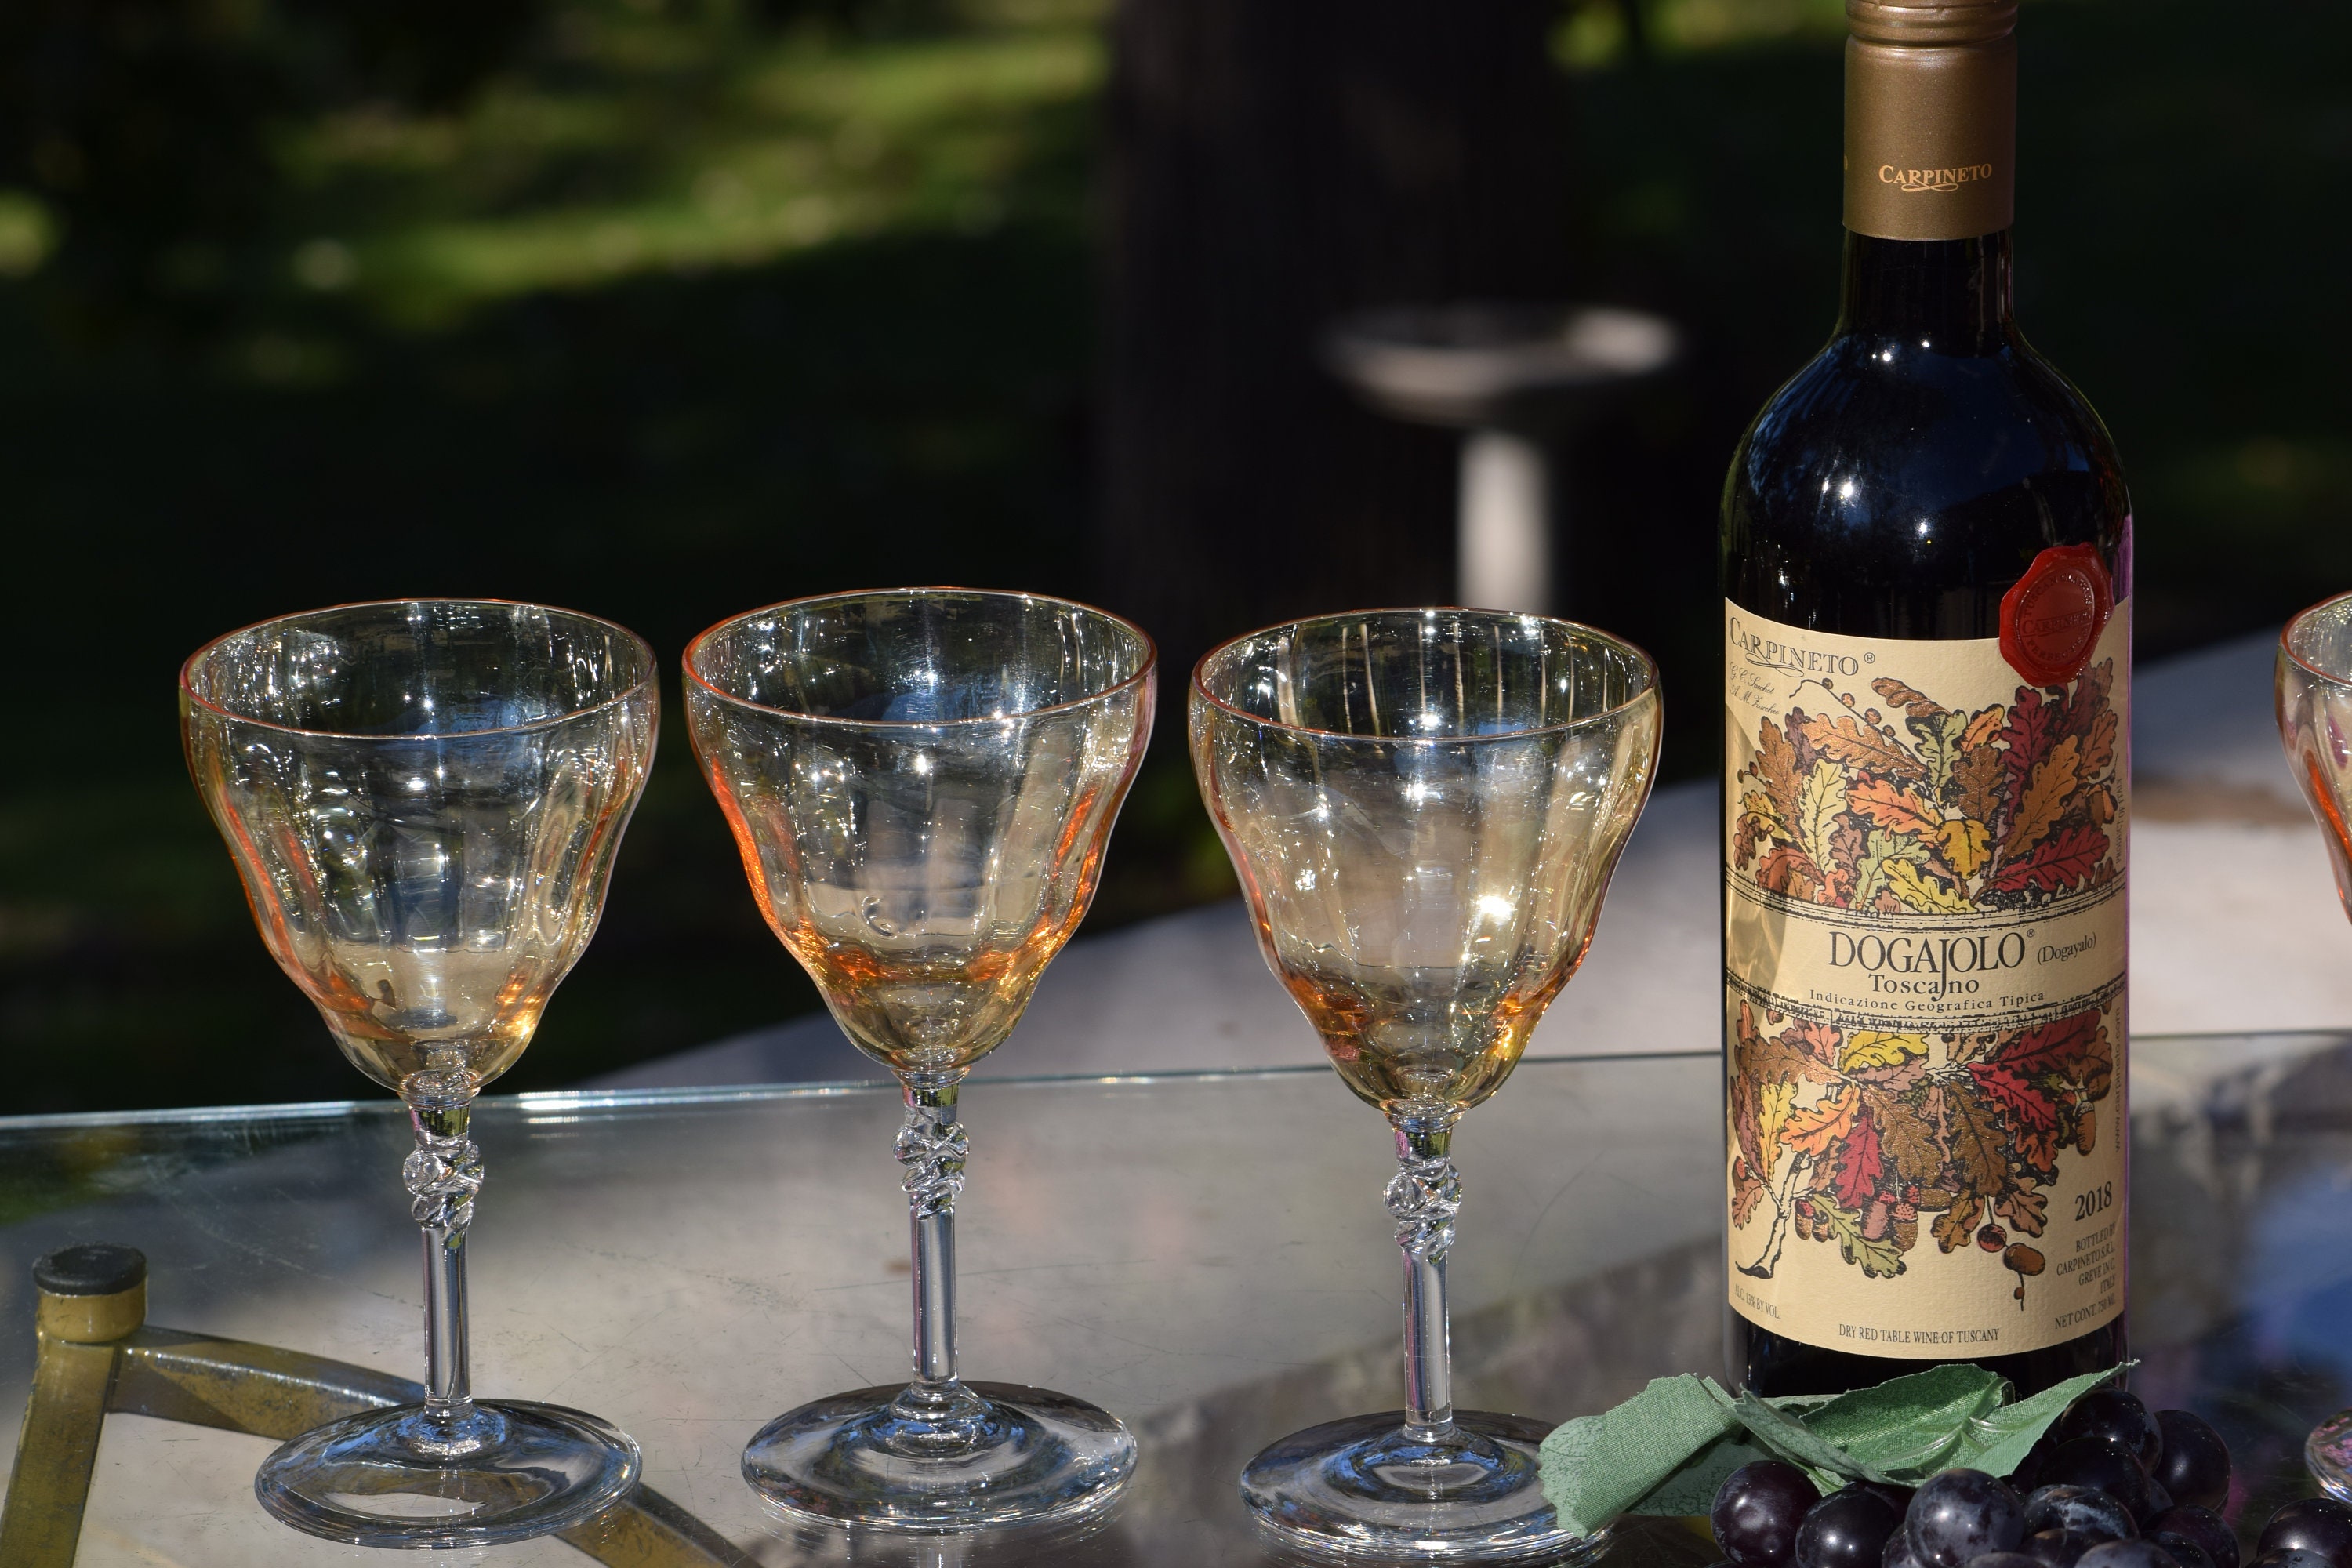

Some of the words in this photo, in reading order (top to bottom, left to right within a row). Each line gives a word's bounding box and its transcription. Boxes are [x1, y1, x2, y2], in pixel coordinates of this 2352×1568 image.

[1878, 163, 1992, 191] CARPINETO
[2037, 931, 2096, 965] (Dogayalo)
[1828, 931, 2025, 1001] DOGAJOLO
[1809, 989, 1898, 1011] Indicazione
[1905, 999, 1992, 1013] Geografica
[1999, 993, 2045, 1008] Tipica
[2074, 1181, 2112, 1221] 2018
[2076, 1227, 2109, 1253] BOTTLED
[2056, 1250, 2100, 1276] CARPINETO
[2078, 1265, 2101, 1286] GREVE
[2100, 1273, 2116, 1294] ITALY
[1756, 1298, 1764, 1312] BY
[1765, 1302, 1781, 1319] VOL.
[2055, 1312, 2073, 1329] NET
[2074, 1304, 2096, 1323] CONT.
[1839, 1323, 1857, 1338] DRY
[1859, 1327, 1878, 1341] RED
[1880, 1329, 1911, 1343] TABLE
[1913, 1331, 1938, 1344] WINE
[1941, 1331, 1954, 1344] OF
[1957, 1328, 1999, 1343] TUSCANY
